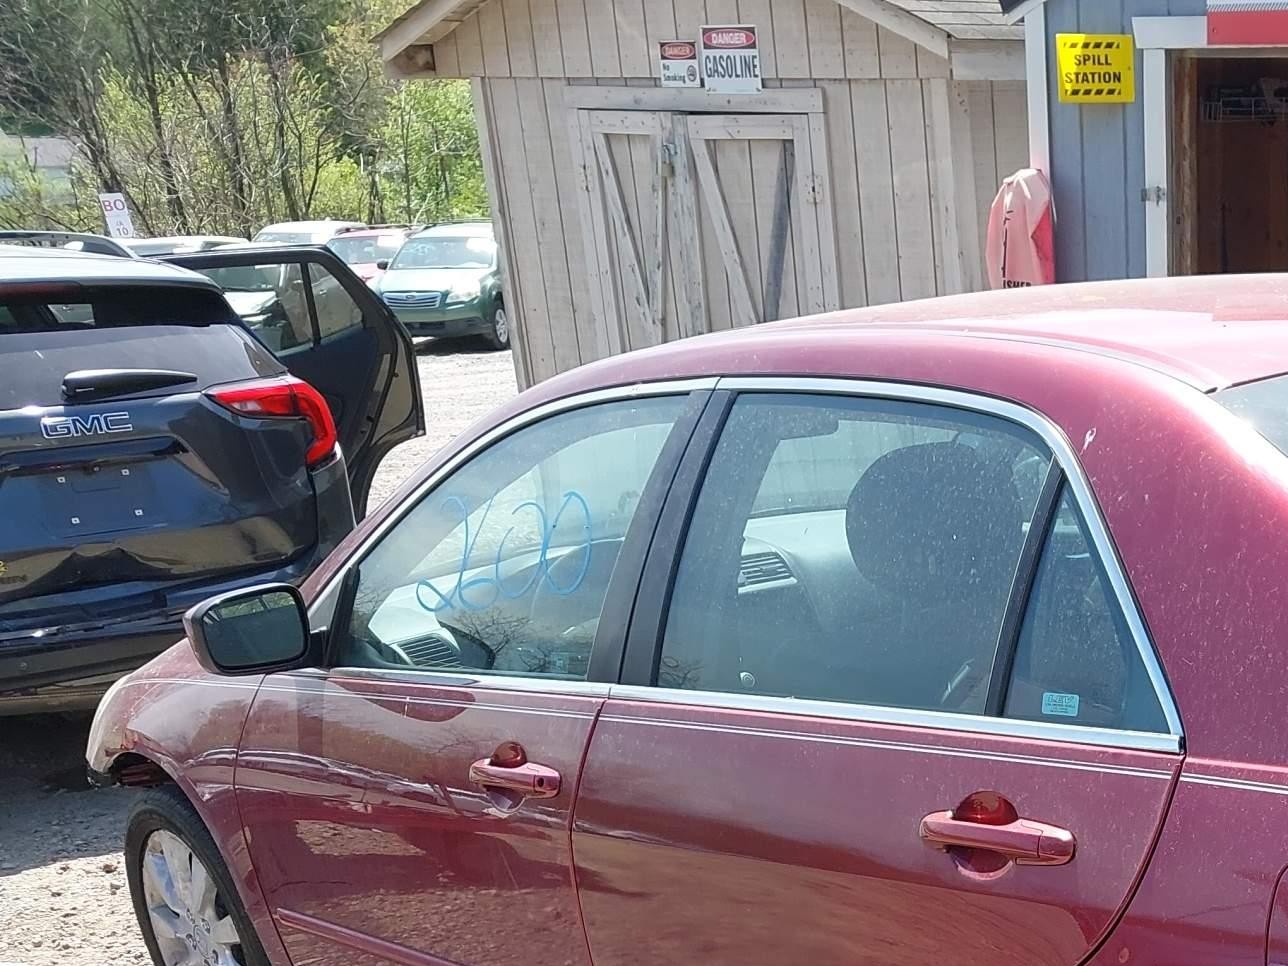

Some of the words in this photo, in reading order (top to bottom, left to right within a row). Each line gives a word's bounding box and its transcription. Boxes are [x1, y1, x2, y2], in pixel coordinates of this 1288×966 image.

[711, 32, 747, 44] DANGER
[1074, 53, 1112, 66] SPILL
[704, 55, 759, 78] GASOLINE
[1064, 71, 1122, 84] STATION
[40, 411, 133, 439] GMC
